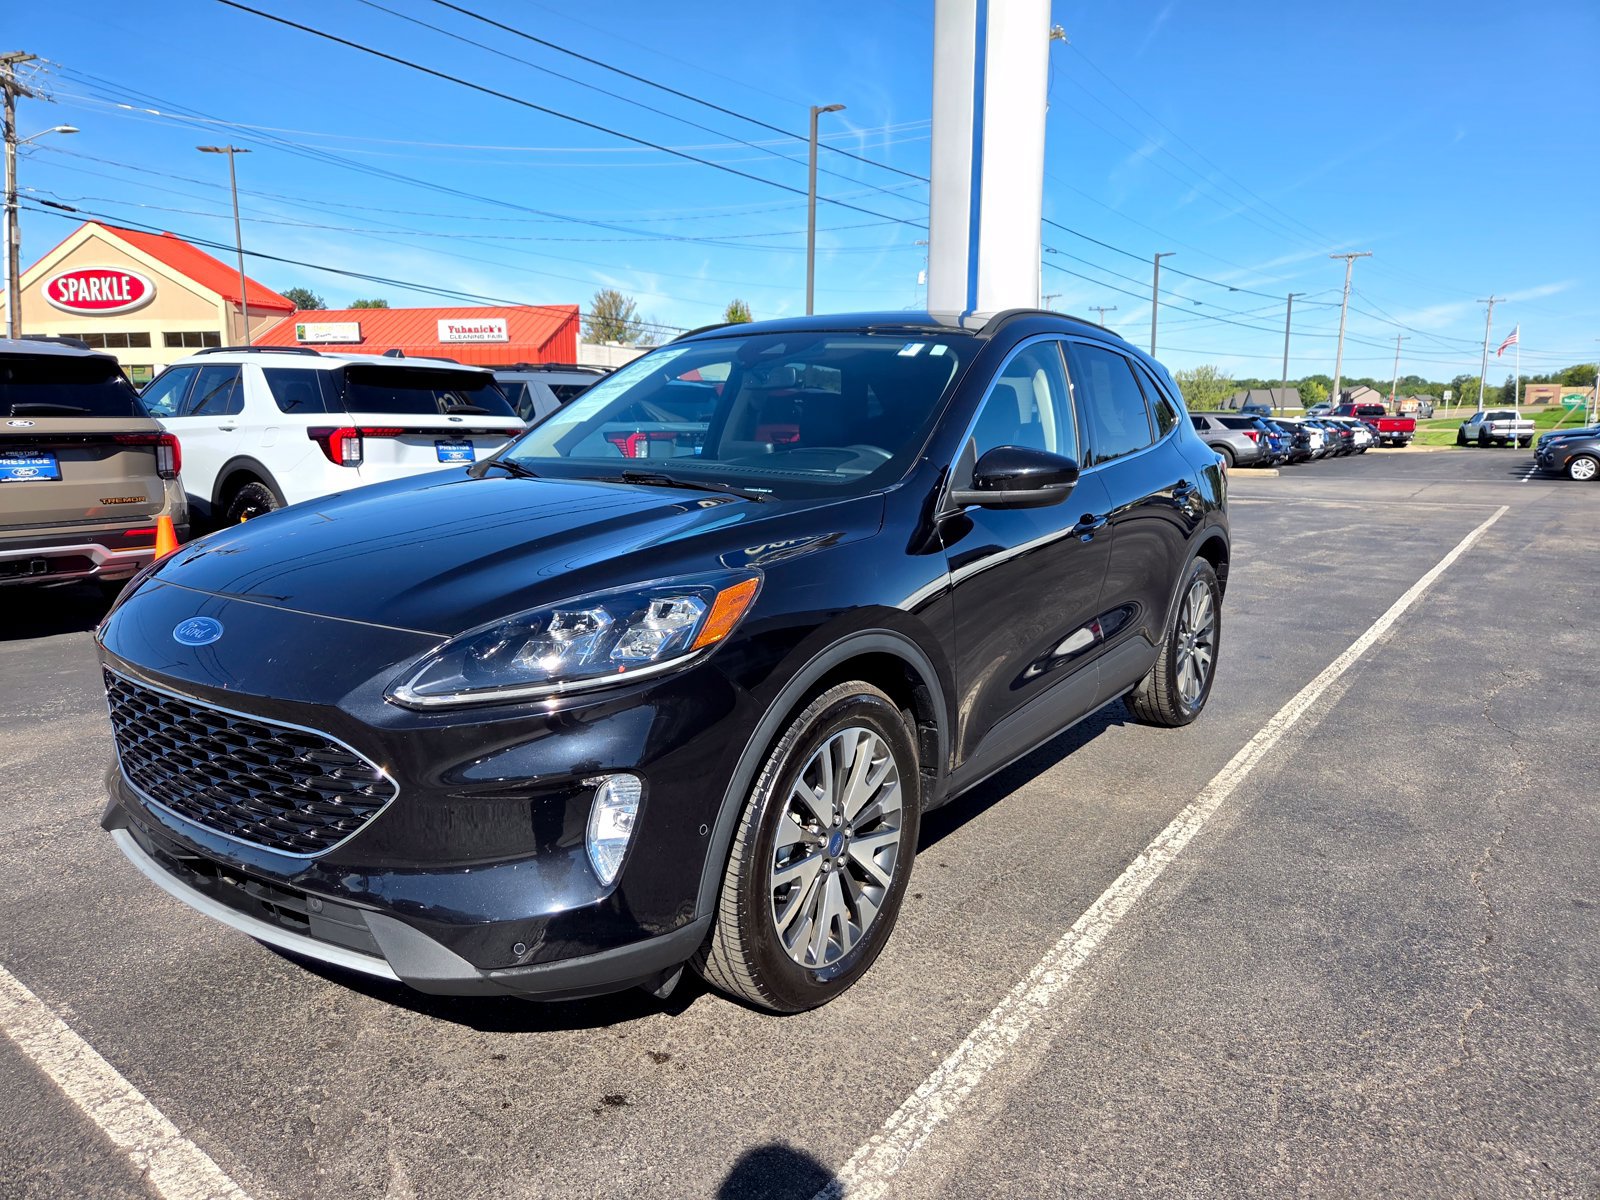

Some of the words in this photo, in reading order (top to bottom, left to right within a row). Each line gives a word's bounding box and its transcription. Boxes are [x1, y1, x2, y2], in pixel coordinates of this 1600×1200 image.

[57, 276, 132, 302] SPARKLE
[100, 496, 145, 505] TREMOR
[180, 620, 211, 639] Ford
